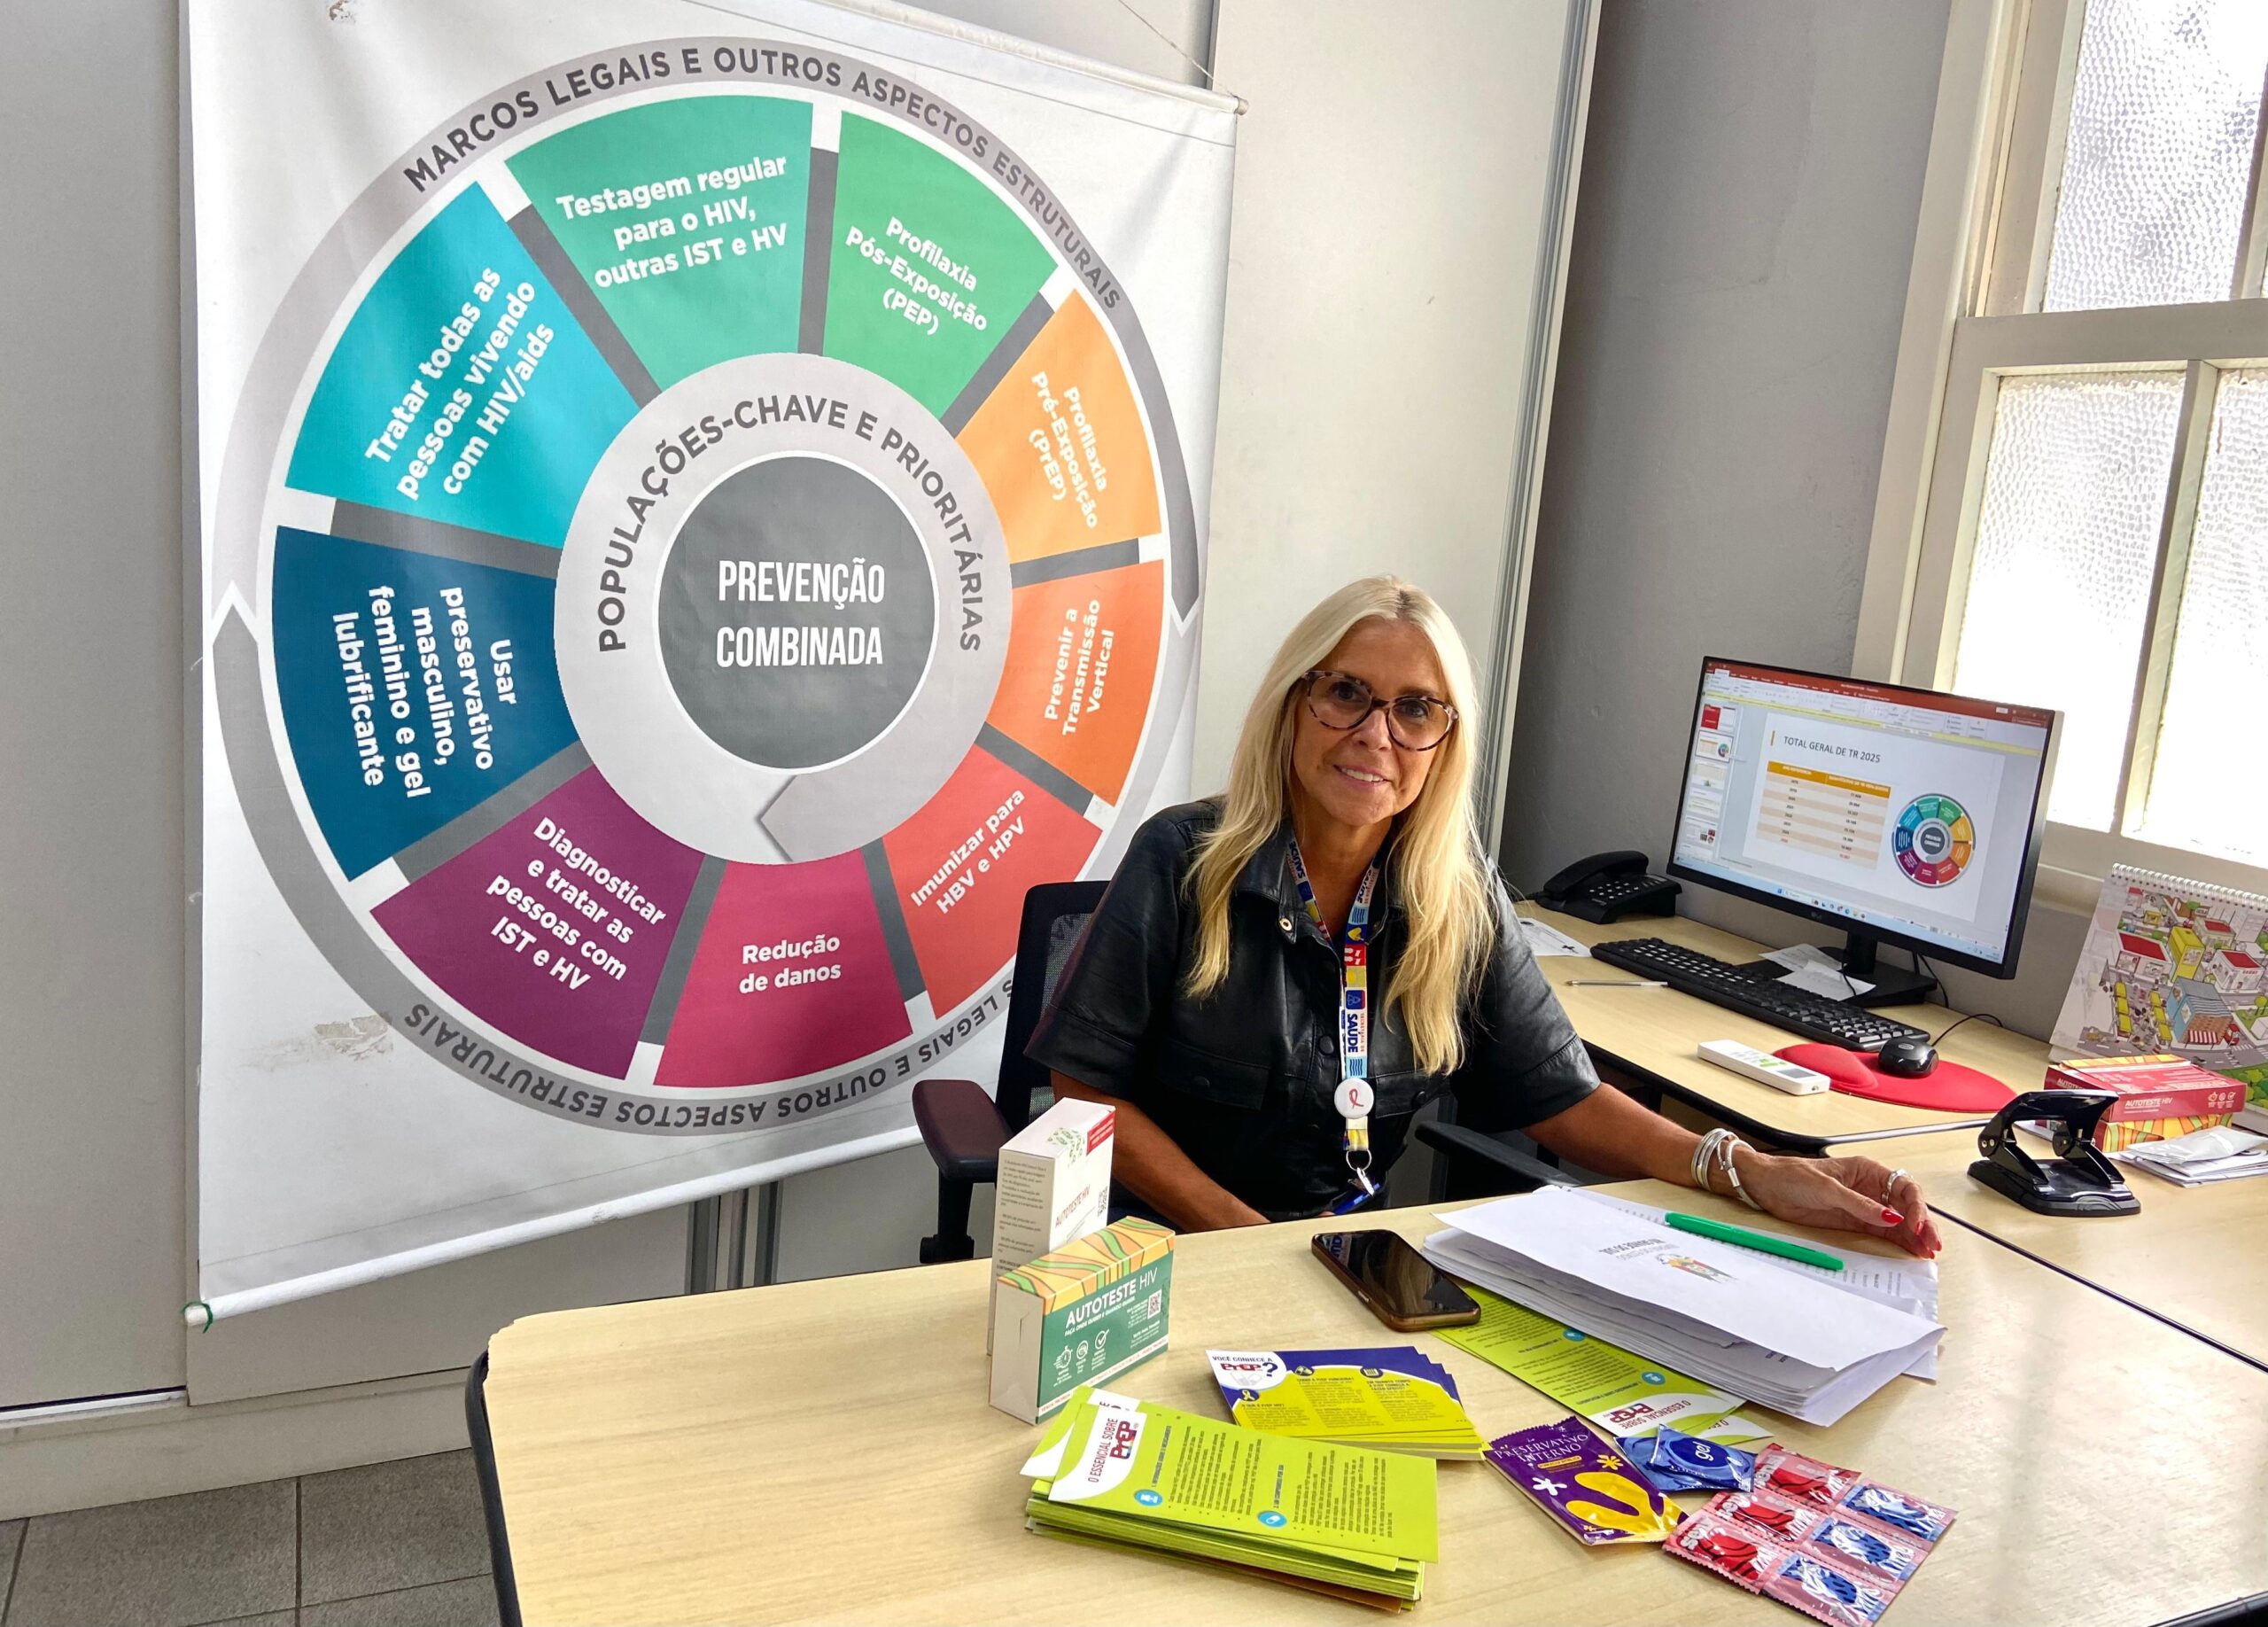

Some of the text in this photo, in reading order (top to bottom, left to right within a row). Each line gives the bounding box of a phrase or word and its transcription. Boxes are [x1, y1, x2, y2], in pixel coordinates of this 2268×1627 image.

[403, 47, 1121, 310] MARCOS LEGAIS E OUTROS ASPECTOS ESTRUTURAIS
[555, 155, 787, 220] Testagem regular
[594, 222, 788, 288] outras IST e HV
[613, 196, 756, 251] para o HIV,
[885, 216, 978, 292] Profilaxia
[844, 226, 988, 331] Pós-Exposição
[882, 288, 939, 336] (PEP)
[364, 268, 501, 463] Tratar todas as
[396, 282, 536, 502] pessoas vivendo
[443, 323, 554, 495] com HIV/aids
[1063, 385, 1107, 492] Profilaxia
[1029, 428, 1067, 501] (PrEP)
[1031, 370, 1099, 529] Pré-Exposição
[597, 394, 983, 652] POPULAÇÕES-CHAVE E PRIORITÁRIAS
[718, 557, 885, 611] PREVENÇÃO
[439, 587, 493, 770] preservativo
[490, 639, 517, 705] Usar
[716, 627, 883, 668] COMBINADA
[1044, 608, 1078, 720] Prevenir a
[1061, 599, 1100, 736] Transmissão
[1086, 629, 1115, 713] Vertical
[332, 611, 385, 787] lubrificante
[369, 585, 431, 798] feminino e gel
[411, 606, 455, 767] masculino,
[1783, 736, 1881, 763] TOTAL GERAL DE TR 2025
[532, 816, 667, 925] Diagnosticar
[910, 789, 1026, 907] Imunizar para
[935, 815, 1026, 915] HBV e HPV
[485, 874, 627, 981] pessoas com
[527, 859, 634, 944] e tratar as
[490, 915, 592, 991] IST e HV
[739, 961, 842, 994] de danos
[742, 933, 841, 965] Redução
[404, 995, 998, 1128] LEGAIS E OUTROS ASPECTOS ESTRUTURAIS
[1348, 1014, 1361, 1053] SAÚDE
[2125, 1098, 2162, 1107] AUTOTESTE
[1055, 1192, 1082, 1228] AUTOTESTE
[1066, 1279, 1137, 1328] AUTOTESTE
[1139, 1267, 1158, 1289] HIV
[1090, 1442, 1111, 1476] ESSENCIAL
[1102, 1418, 1118, 1440] SOBRE
[1109, 1421, 1137, 1460] PrEP
[1494, 1434, 1588, 1459] PRESERVATIVO
[1621, 1418, 1646, 1429] SOBRE
[1648, 1402, 1683, 1421] ESSENCIAL
[1518, 1443, 1581, 1462] INTERNO
[1692, 1441, 1713, 1461] gel
